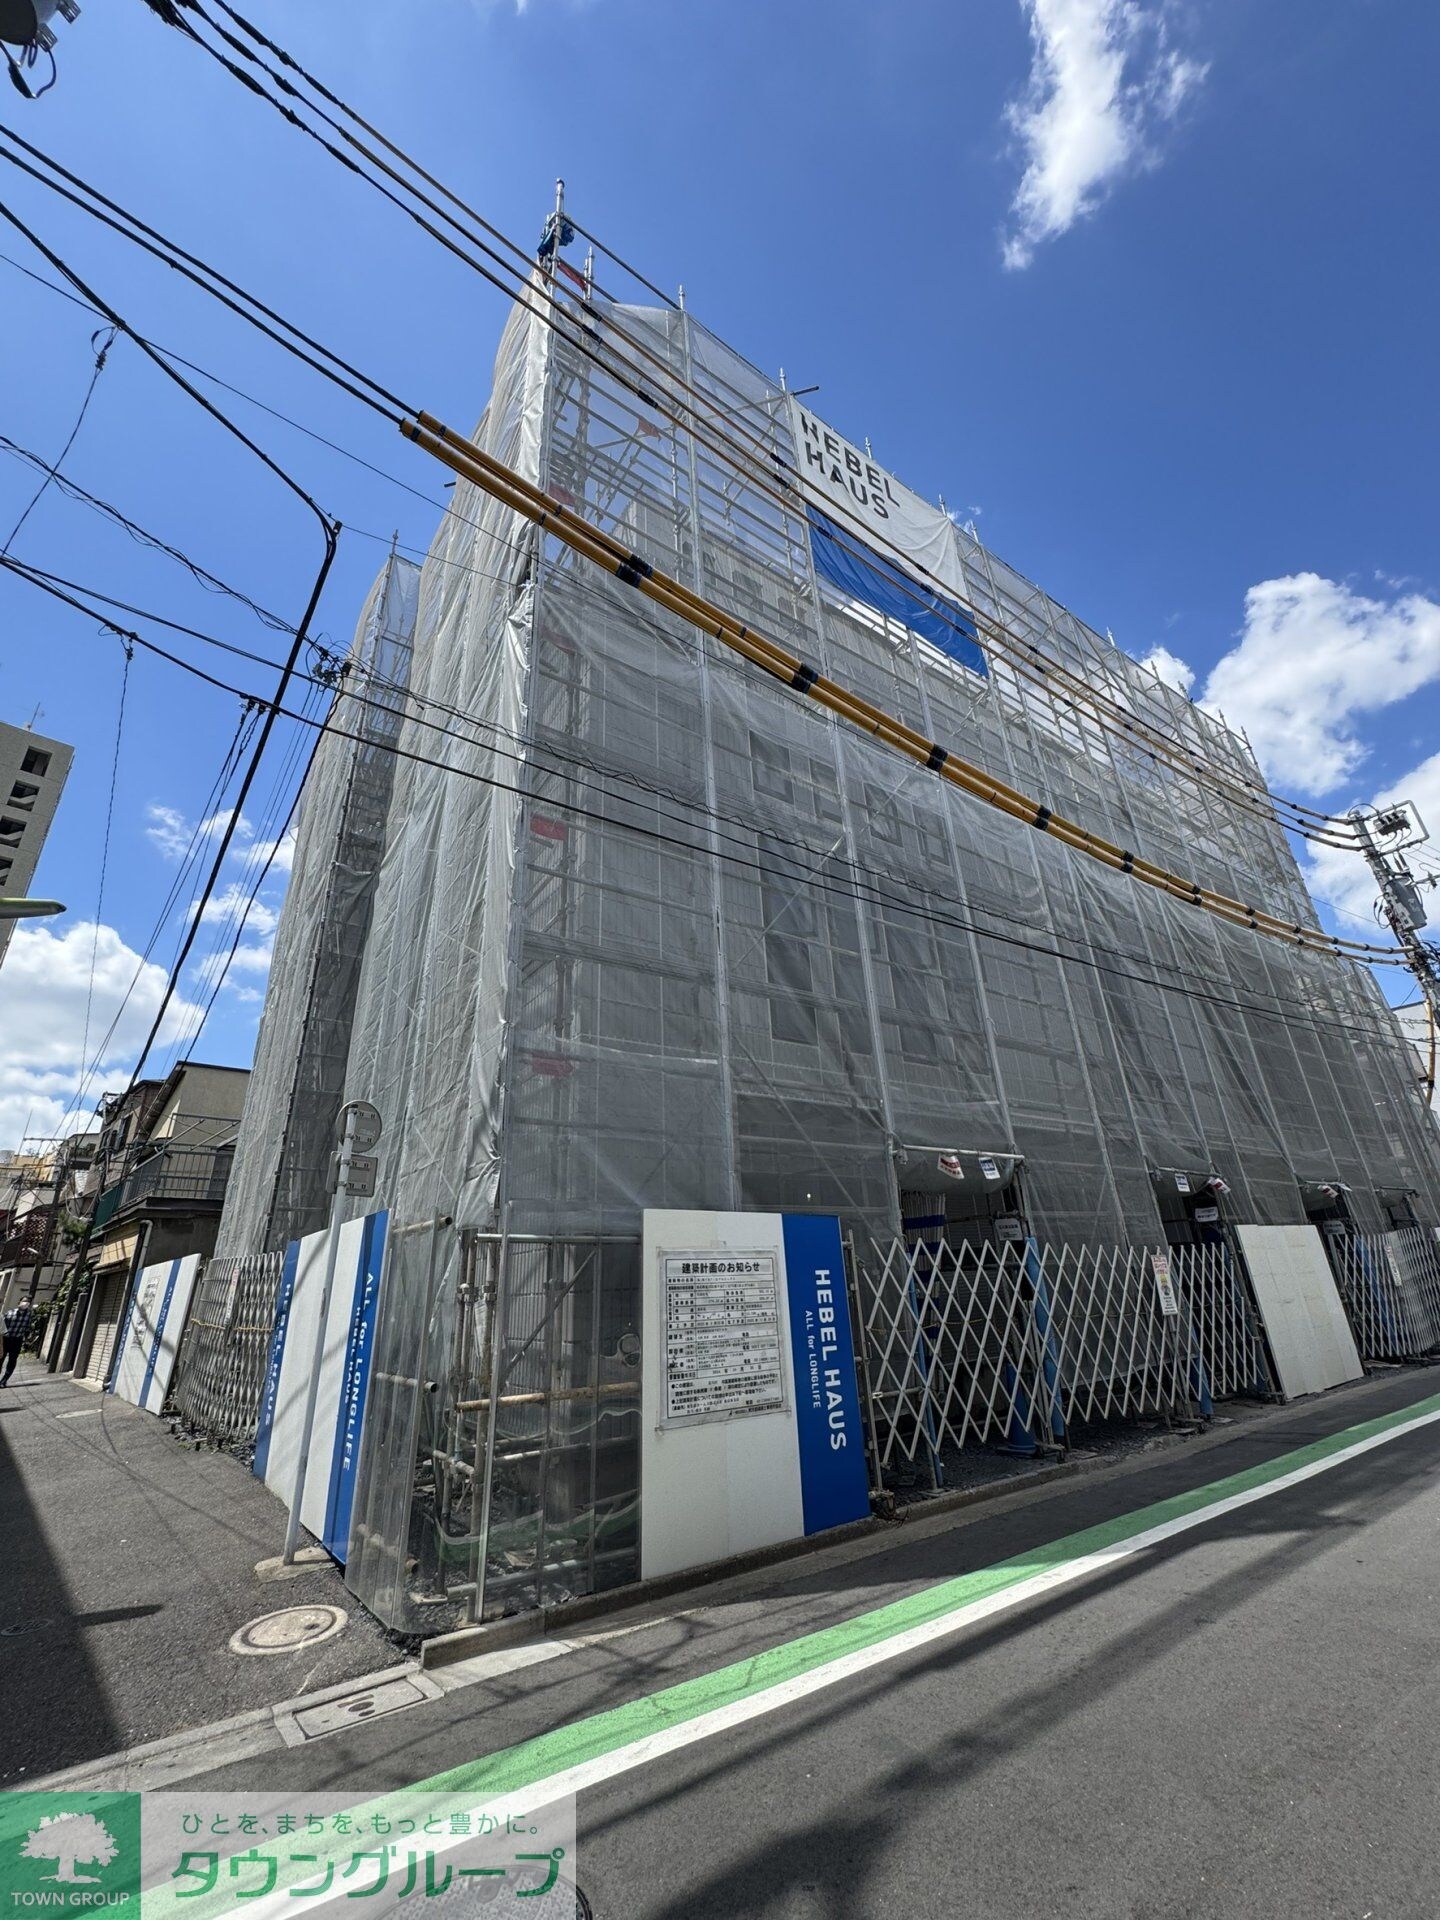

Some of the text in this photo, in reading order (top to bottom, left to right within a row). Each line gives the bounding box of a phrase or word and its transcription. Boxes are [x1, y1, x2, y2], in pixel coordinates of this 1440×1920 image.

[804, 441, 889, 519] HAUS
[681, 1262, 760, 1274] 建築計画のお知らせ
[343, 1273, 373, 1472] ALL for LONGLIFE
[805, 1310, 822, 1408] ALL for LONGLIFE
[814, 1269, 846, 1450] HEBEL HAUS
